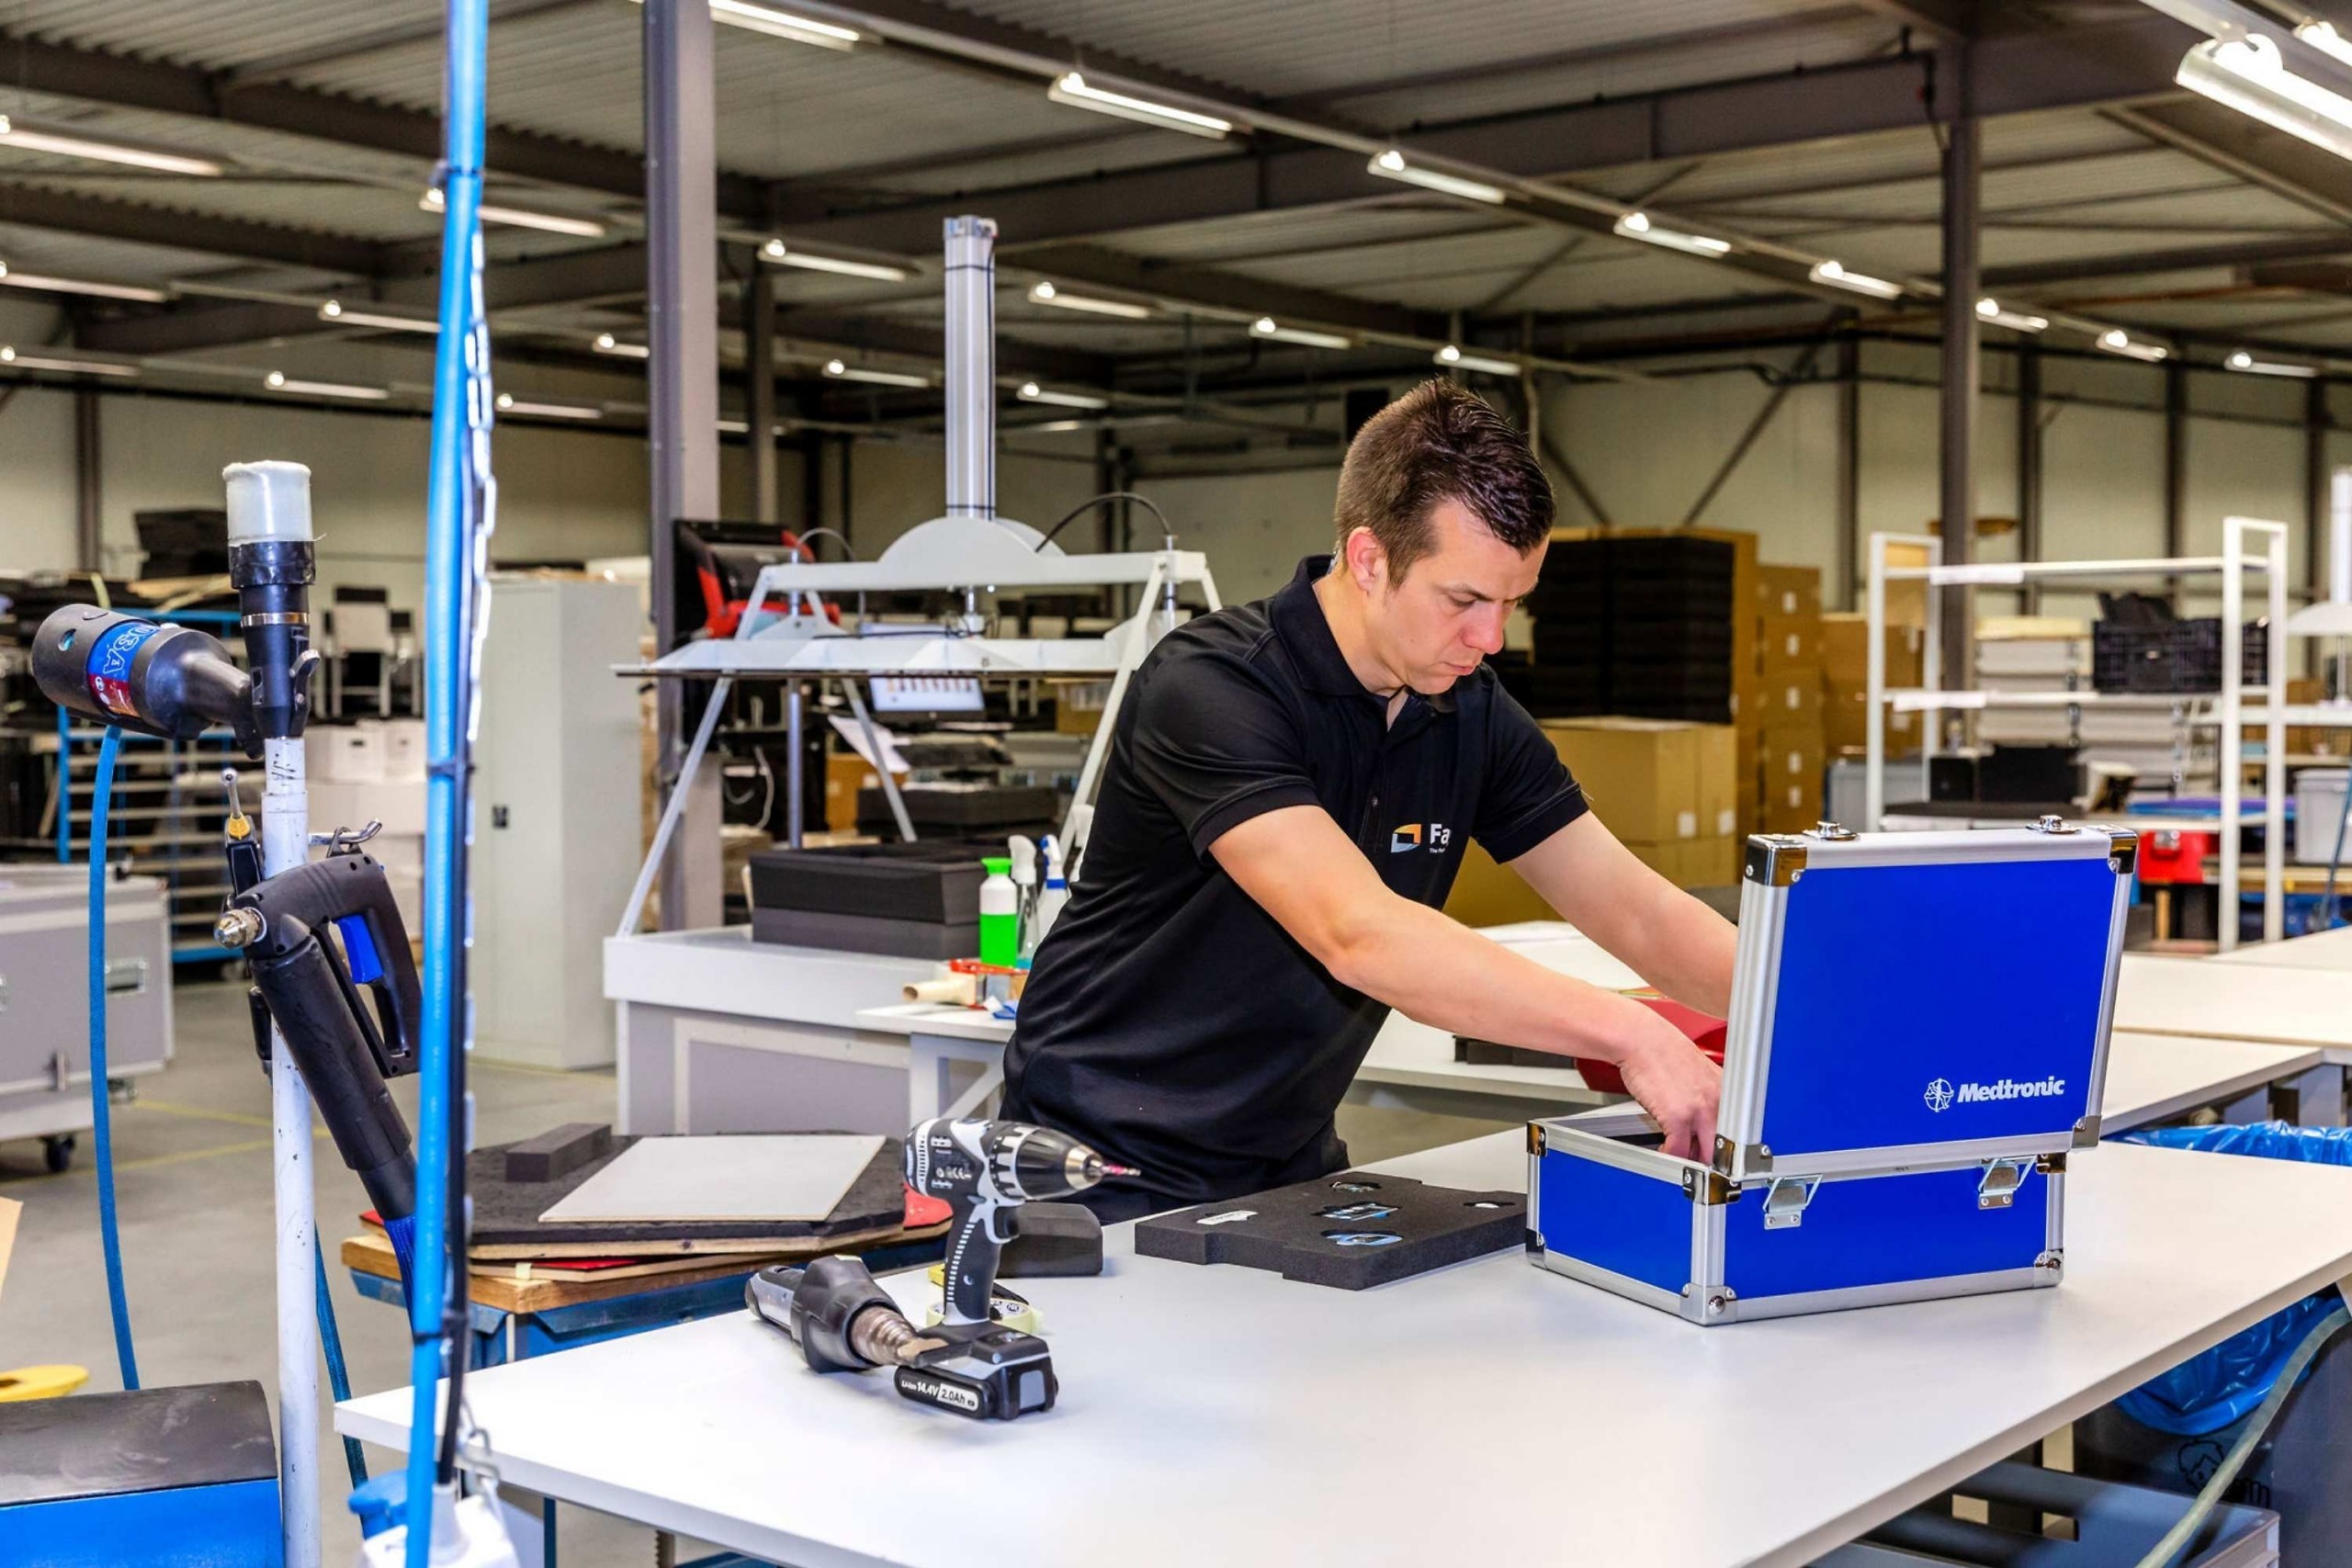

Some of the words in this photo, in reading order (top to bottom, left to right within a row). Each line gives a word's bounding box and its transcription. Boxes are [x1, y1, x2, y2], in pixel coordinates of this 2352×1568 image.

[1957, 1076, 2065, 1103] Medtronic
[917, 1381, 939, 1396] 14.4V
[941, 1388, 966, 1404] 2.0Ah
